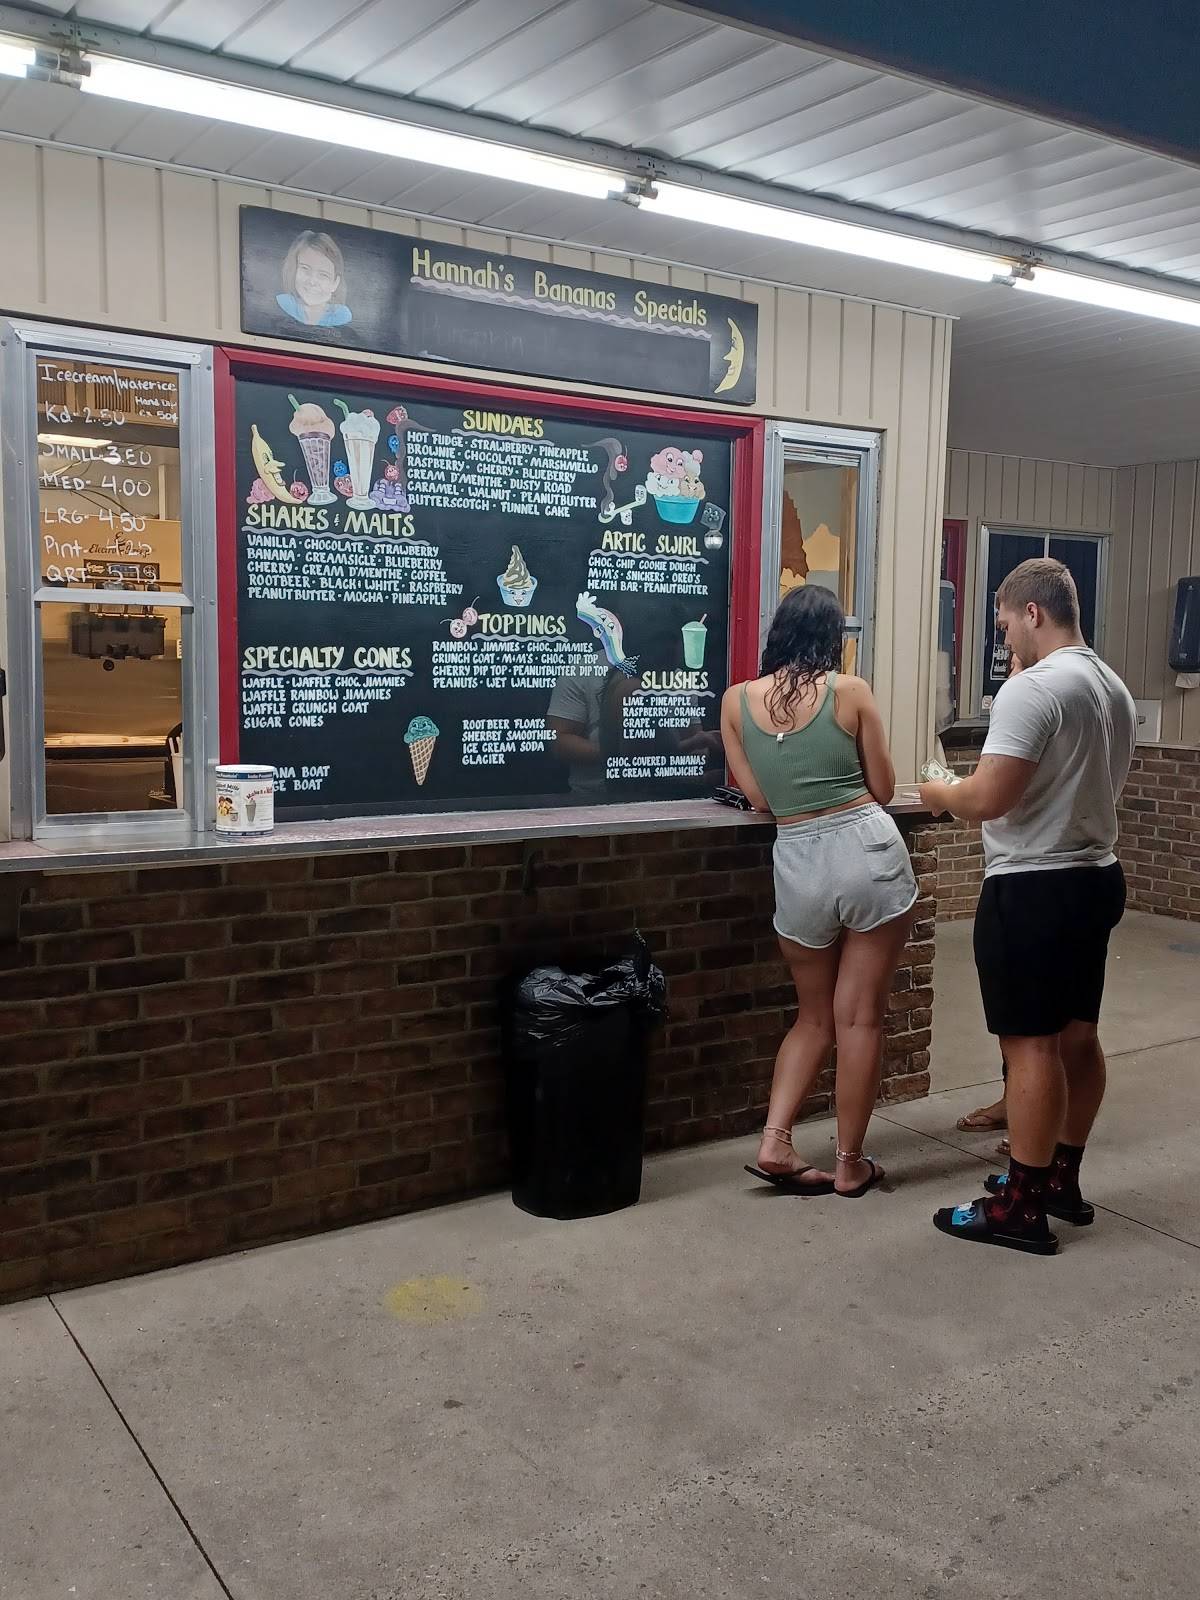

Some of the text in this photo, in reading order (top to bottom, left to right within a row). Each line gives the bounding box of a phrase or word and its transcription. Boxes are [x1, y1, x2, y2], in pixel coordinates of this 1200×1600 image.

[412, 248, 707, 326] Hannah's Bananas Specials
[84, 408, 125, 426] 2.50
[463, 410, 544, 438] SUNDAES
[407, 431, 588, 462] HOT FUDGE STRAWBERRY PINEAPPLE
[407, 443, 598, 474] BROWNIE CHOCOLATE MARSHMELLO
[407, 457, 576, 483] RASPBERRY CHERRY BLUEBERRY
[102, 476, 152, 496] 4.00
[407, 469, 446, 482] CREAM
[510, 478, 540, 491] DUSTY
[544, 480, 572, 494] ROAD
[407, 482, 459, 496] CARAMEL
[468, 486, 511, 500] WALNUT
[407, 494, 570, 518] BUTTERSCOTCH FUNNEL CAKE
[99, 508, 146, 532] 4.50
[246, 504, 329, 530] SHAKES
[344, 511, 416, 537] MALTS
[247, 535, 439, 558] VANILLA CHOCOLATE STRAWBERRY
[602, 530, 701, 556] ARTIC SWIRL
[247, 548, 442, 570] BANANA CREAMSICLE BLUEBERRY
[616, 558, 636, 569] CHIP
[638, 560, 668, 572] COOKIE
[670, 562, 696, 572] DOUGH
[247, 562, 293, 574] CHERRY
[302, 564, 344, 577] CREAM
[411, 570, 448, 582] COFFEE
[626, 570, 664, 582] SNICKERS
[672, 574, 700, 584] OREO'S
[320, 577, 356, 590] BLACK
[364, 580, 400, 592] WHITE
[409, 582, 464, 595] RASPBERRY
[588, 580, 617, 590] HEATH
[620, 580, 638, 592] BAR
[344, 592, 384, 603] MOCHA
[392, 592, 448, 606] PINEAPPLE
[478, 614, 566, 635] TOPPINGS
[432, 641, 478, 652] RAINBOW
[481, 642, 520, 652] JIMMIES
[554, 642, 593, 652] JIMMIES
[242, 646, 412, 669] SPECIALTY CONES
[432, 653, 468, 664] CRUNCH
[472, 654, 495, 664] COAT
[568, 654, 581, 664] DIP
[583, 654, 599, 664] TOP
[432, 665, 470, 676] CHERRY
[473, 666, 488, 676] DIP
[490, 665, 507, 676] TOP
[579, 666, 592, 676] DIP
[594, 665, 608, 676] TOP
[242, 678, 284, 688] WAFFLE
[292, 677, 331, 688] WAFFLE
[362, 676, 405, 687] JIMMIES
[433, 678, 556, 689] PEANUTS WET WALNUTS
[641, 671, 708, 690] SLUSHES
[242, 689, 391, 702] WAFFLE RAINBOW JIMMIES
[622, 696, 691, 706] LIME PINEAPPLE
[243, 702, 369, 715] WAFFLE CRUNCH COAT
[622, 707, 706, 717] RASPBERRY ORANGE
[244, 716, 324, 729] SUGAR CONES
[514, 718, 545, 729] FLOATS
[622, 718, 690, 728] GRAPE CHERRY
[462, 730, 557, 742] SHERBET SMOOTHIES
[623, 728, 655, 739] LEMON
[463, 741, 544, 754] ICE CREAM SODA
[462, 754, 505, 765] GLACIER
[632, 756, 667, 766] COVERED
[670, 755, 706, 766] BANANAS
[273, 766, 295, 778] ANA
[302, 766, 330, 777] BOAT
[606, 766, 704, 778] ICE CREAM SANDWICHES
[294, 779, 322, 790] BOAT
